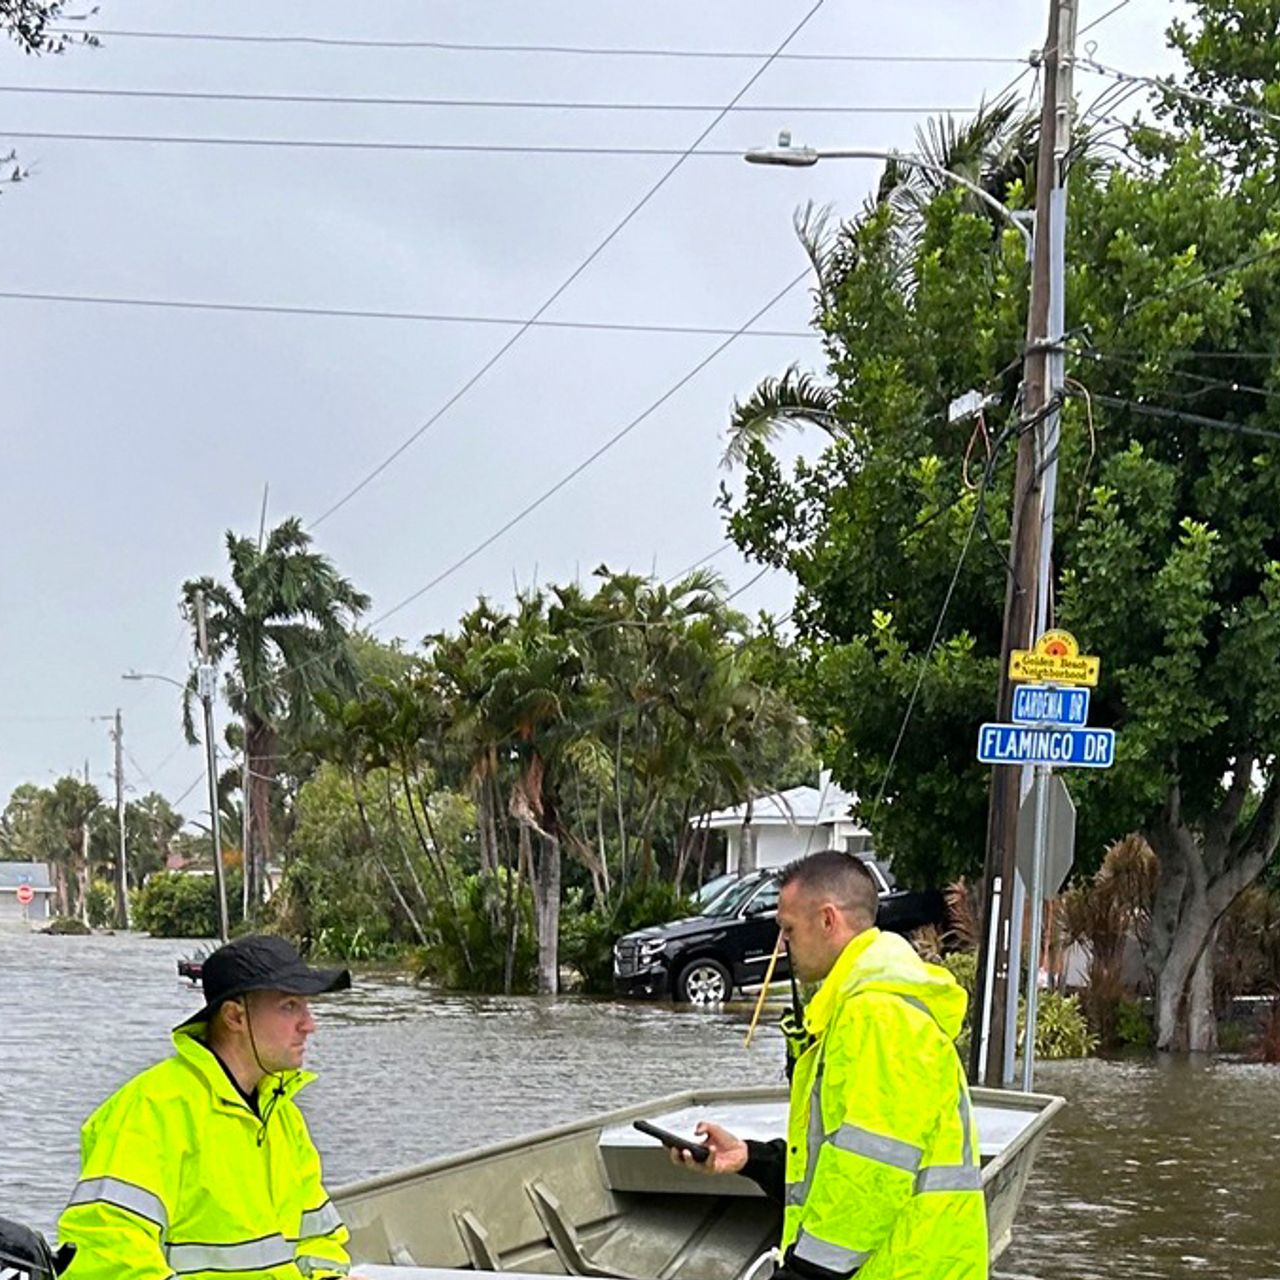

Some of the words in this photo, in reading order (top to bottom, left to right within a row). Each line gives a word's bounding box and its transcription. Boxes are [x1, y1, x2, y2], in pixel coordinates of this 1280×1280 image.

[1069, 693, 1084, 721] DR
[983, 729, 1074, 760] FLAMINGO
[1083, 734, 1108, 762] DR
